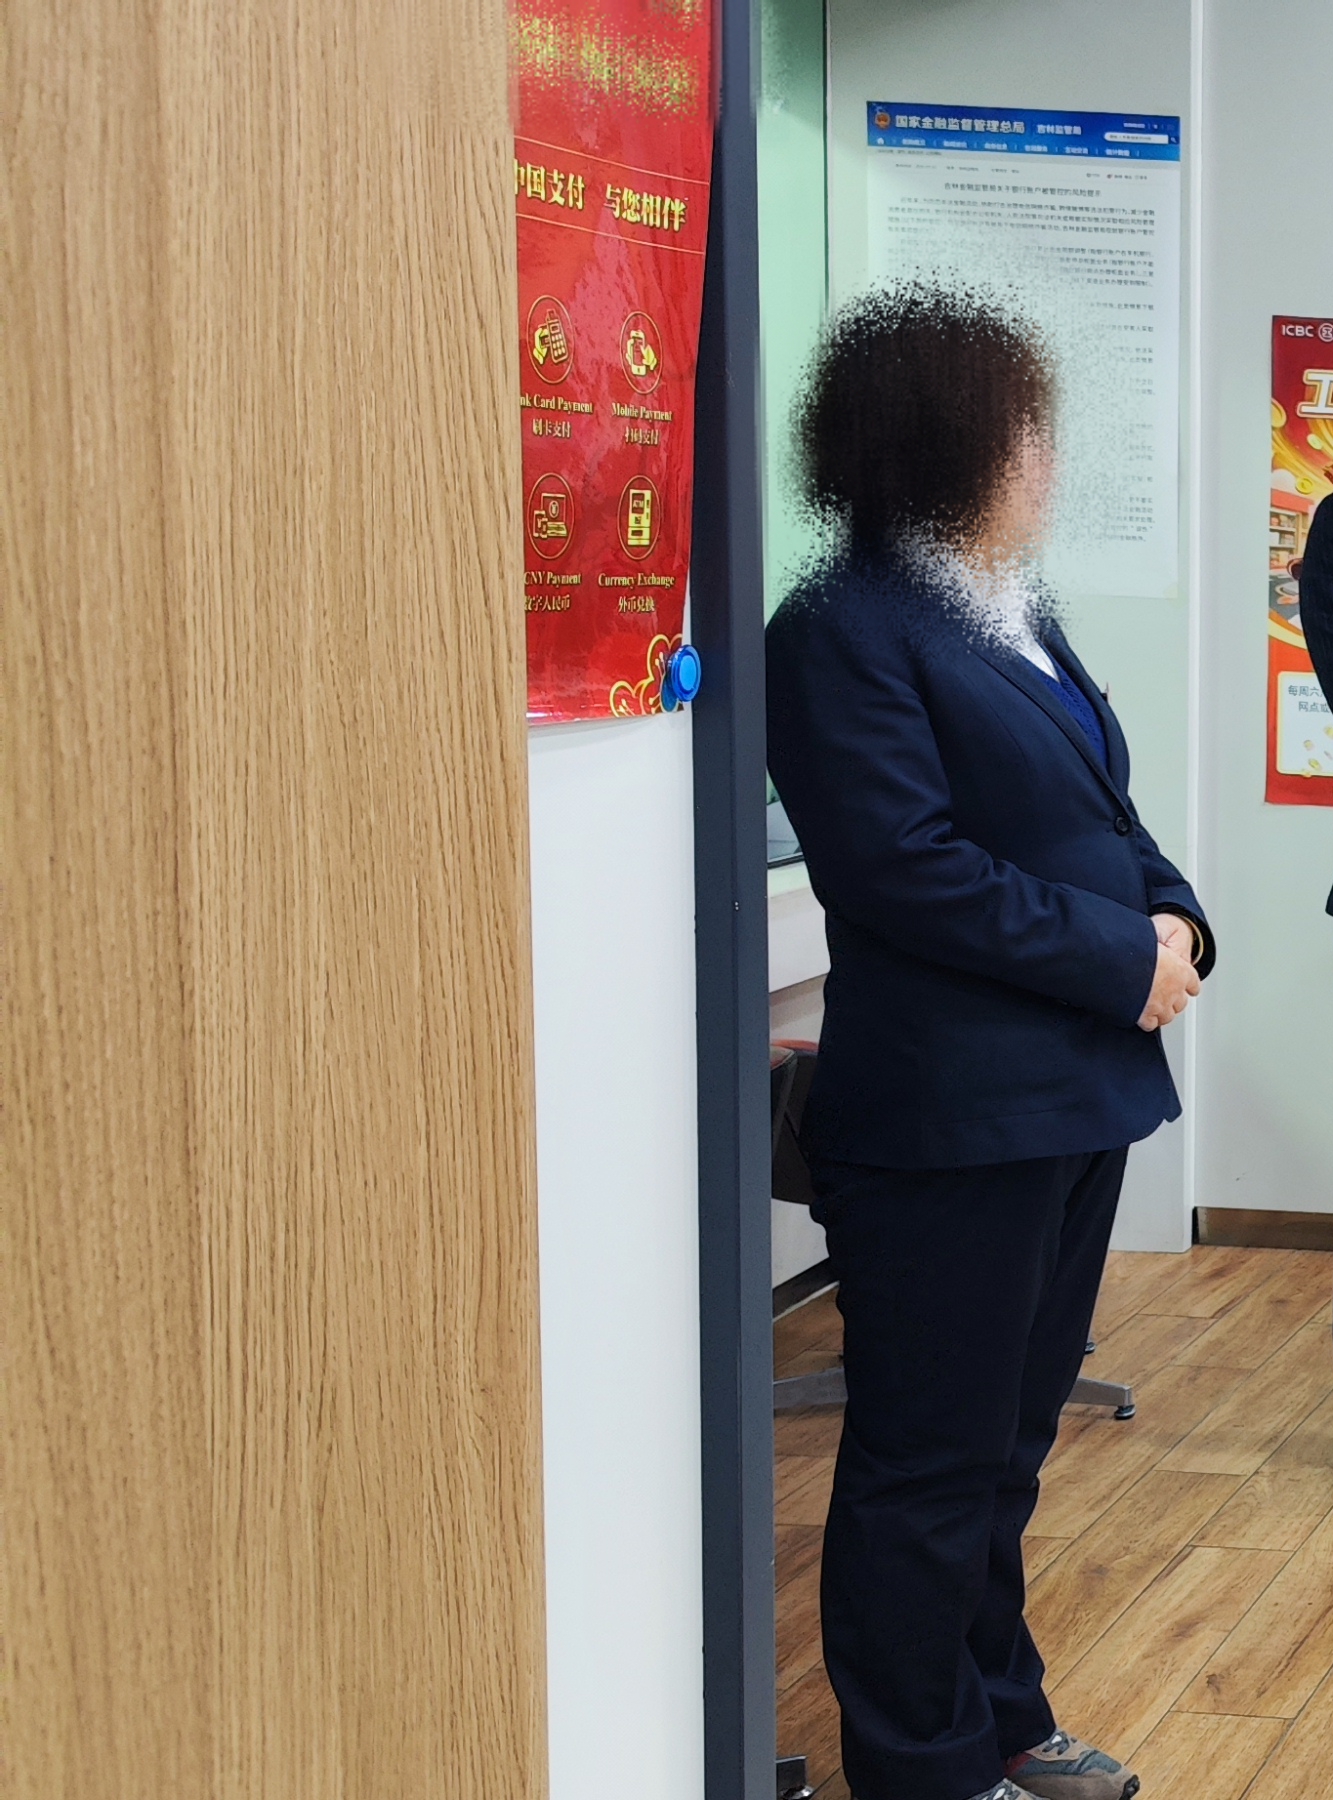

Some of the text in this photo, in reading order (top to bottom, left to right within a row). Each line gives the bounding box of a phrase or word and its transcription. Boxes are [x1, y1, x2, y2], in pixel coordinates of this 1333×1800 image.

[895, 114, 1026, 134] 国家金融监督管理总局
[603, 183, 687, 232] 与您相伴
[1281, 324, 1315, 338] ICBC
[520, 392, 594, 415] nk Card Payment
[611, 402, 673, 423] Mobile Payment
[532, 417, 571, 438] 刷卡支付
[625, 425, 659, 445] 扫码支付
[524, 571, 582, 588] CNY Payment
[597, 572, 675, 589] Currency Exchange
[524, 594, 570, 612] 数字人民币
[618, 595, 656, 614] 外币兑换
[1287, 684, 1324, 698] 每周六
